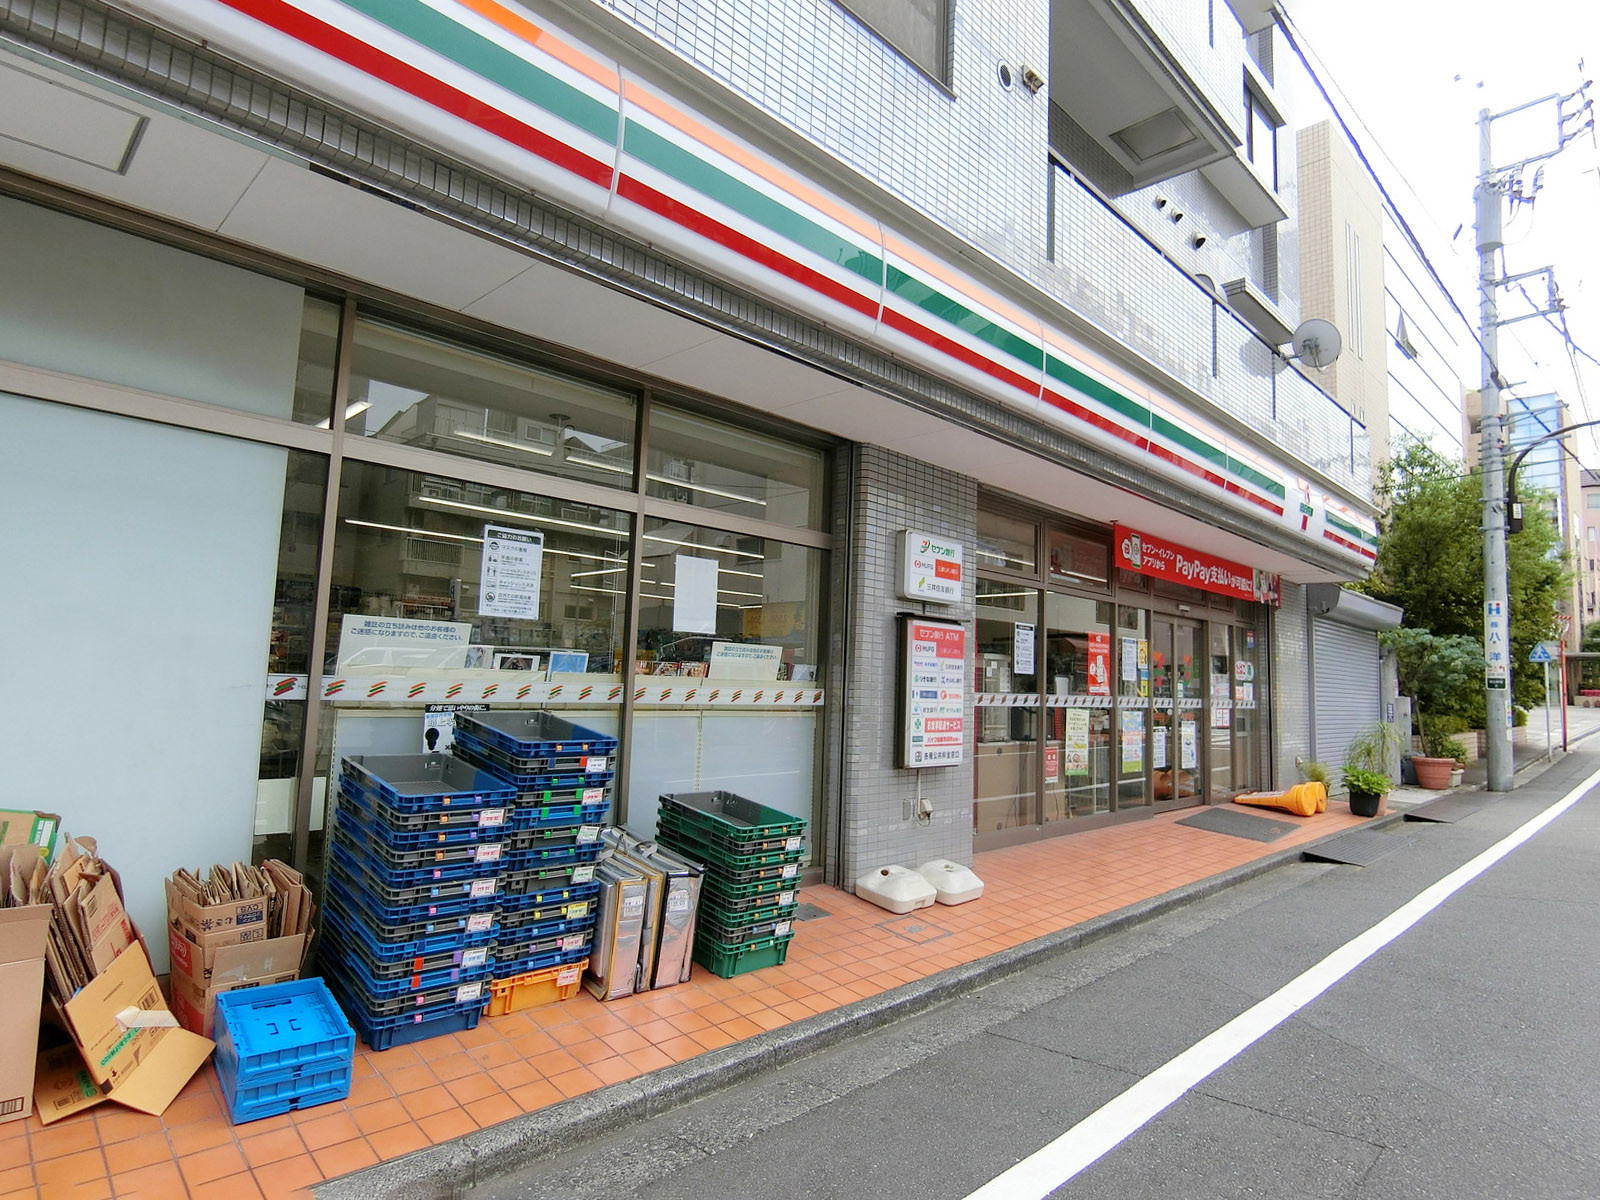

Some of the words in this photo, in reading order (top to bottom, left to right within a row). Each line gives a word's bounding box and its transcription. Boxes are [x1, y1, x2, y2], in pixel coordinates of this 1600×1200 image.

[931, 545, 955, 557] セブン銀行
[1142, 556, 1166, 571] アプリから
[926, 583, 954, 595] 三井住友銀行
[364, 620, 456, 633] 雑誌の立ち読みは他のお客様の
[945, 632, 959, 640] ATM
[240, 904, 259, 913] CVS
